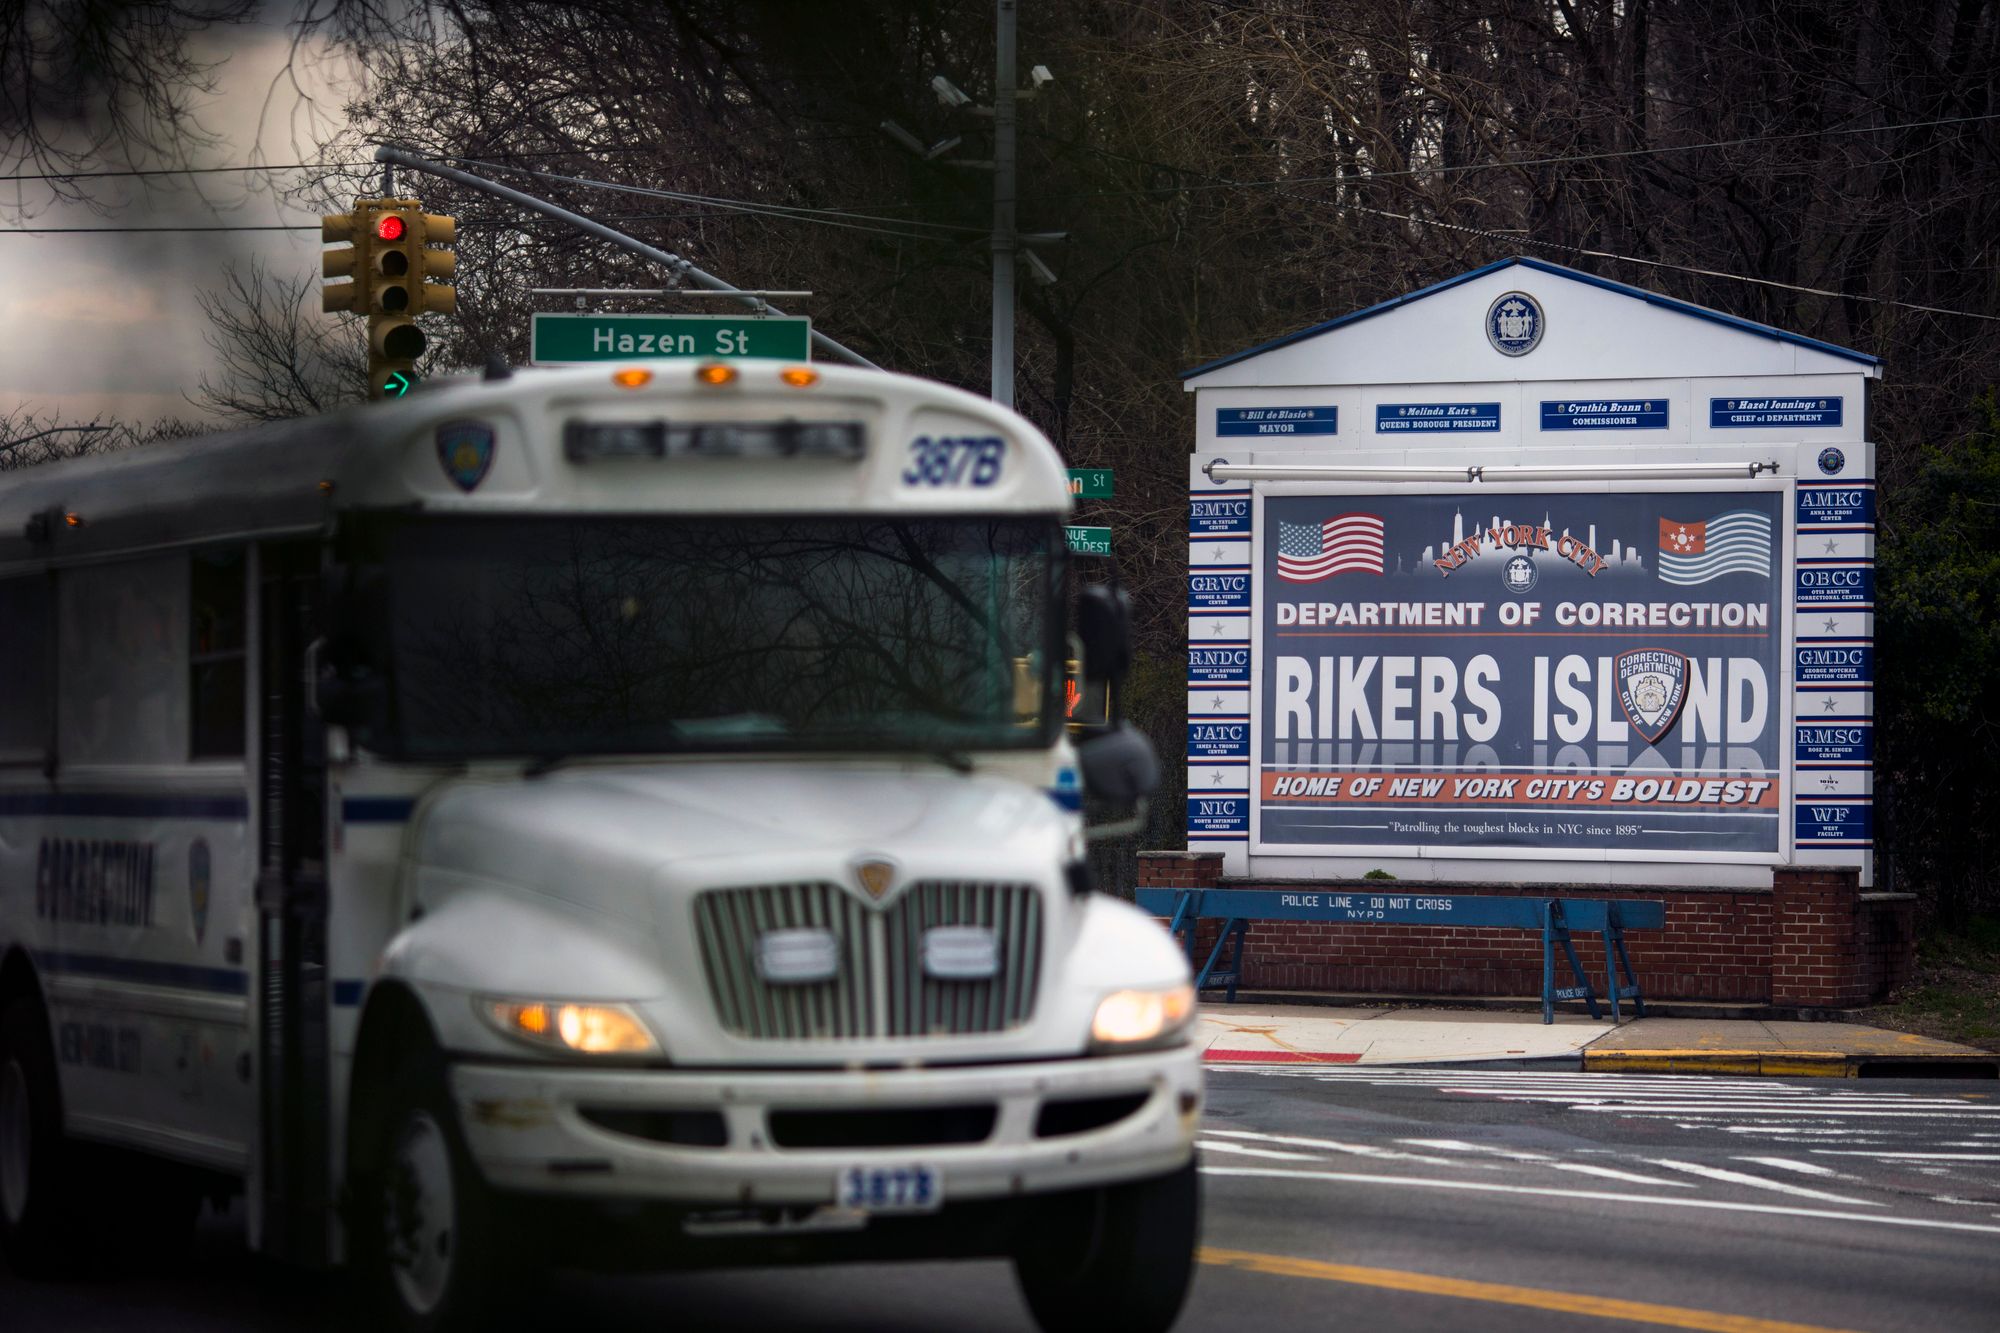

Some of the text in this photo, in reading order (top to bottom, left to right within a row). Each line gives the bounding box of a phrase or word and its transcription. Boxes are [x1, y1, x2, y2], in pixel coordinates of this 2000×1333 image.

[593, 328, 749, 354] Hazen St
[1407, 406, 1469, 416] Melinda Katz
[1568, 403, 1641, 414] Cynthia Brann
[1738, 400, 1816, 411] Hazel Jennings
[1247, 410, 1307, 420] Bill de Blasio
[1572, 417, 1637, 425] COMMISSIONER
[1767, 414, 1822, 422] DEPARTMENT
[1259, 424, 1295, 433] MAYOR
[1380, 420, 1497, 430] QUEENS BOROUGH PRESIDENT
[901, 435, 1005, 486] 387B
[1093, 473, 1104, 487] St
[1801, 492, 1862, 507] AMKC
[1191, 502, 1246, 516] EMTC
[1434, 534, 1481, 578] NEW
[1488, 524, 1551, 549] YORK
[1557, 535, 1608, 576] CITY
[1191, 577, 1246, 591] GRVC
[1801, 571, 1860, 586] OBCC
[1277, 601, 1769, 627] DEPARTMENT OF CORRECTION
[1188, 651, 1247, 665] RNDC
[1620, 652, 1682, 668] CORRECTION
[1799, 650, 1862, 665] GMDC
[1621, 662, 1681, 679] DEPARTMENT
[1275, 654, 1769, 743] RIKERS ISLND
[1656, 683, 1682, 727] NEW YORK
[1622, 690, 1643, 725] CITY OF
[1193, 726, 1242, 740] JATC
[1798, 729, 1862, 744] RMSC
[1272, 776, 1771, 804] HOME OF NEW YORK CITY'S BOLDEST
[1200, 801, 1236, 815] NIC
[1811, 807, 1850, 822] WF
[1389, 821, 1642, 836] "Patrolling the toughest blocks in NYC since 1895"
[1281, 895, 1319, 907] POLICE
[1329, 896, 1352, 908] LINE
[1370, 897, 1385, 909] DO
[1389, 898, 1411, 910] NOT
[1415, 899, 1452, 911] CROSS
[1347, 910, 1384, 919] NYPD
[1556, 988, 1574, 998] POLICE
